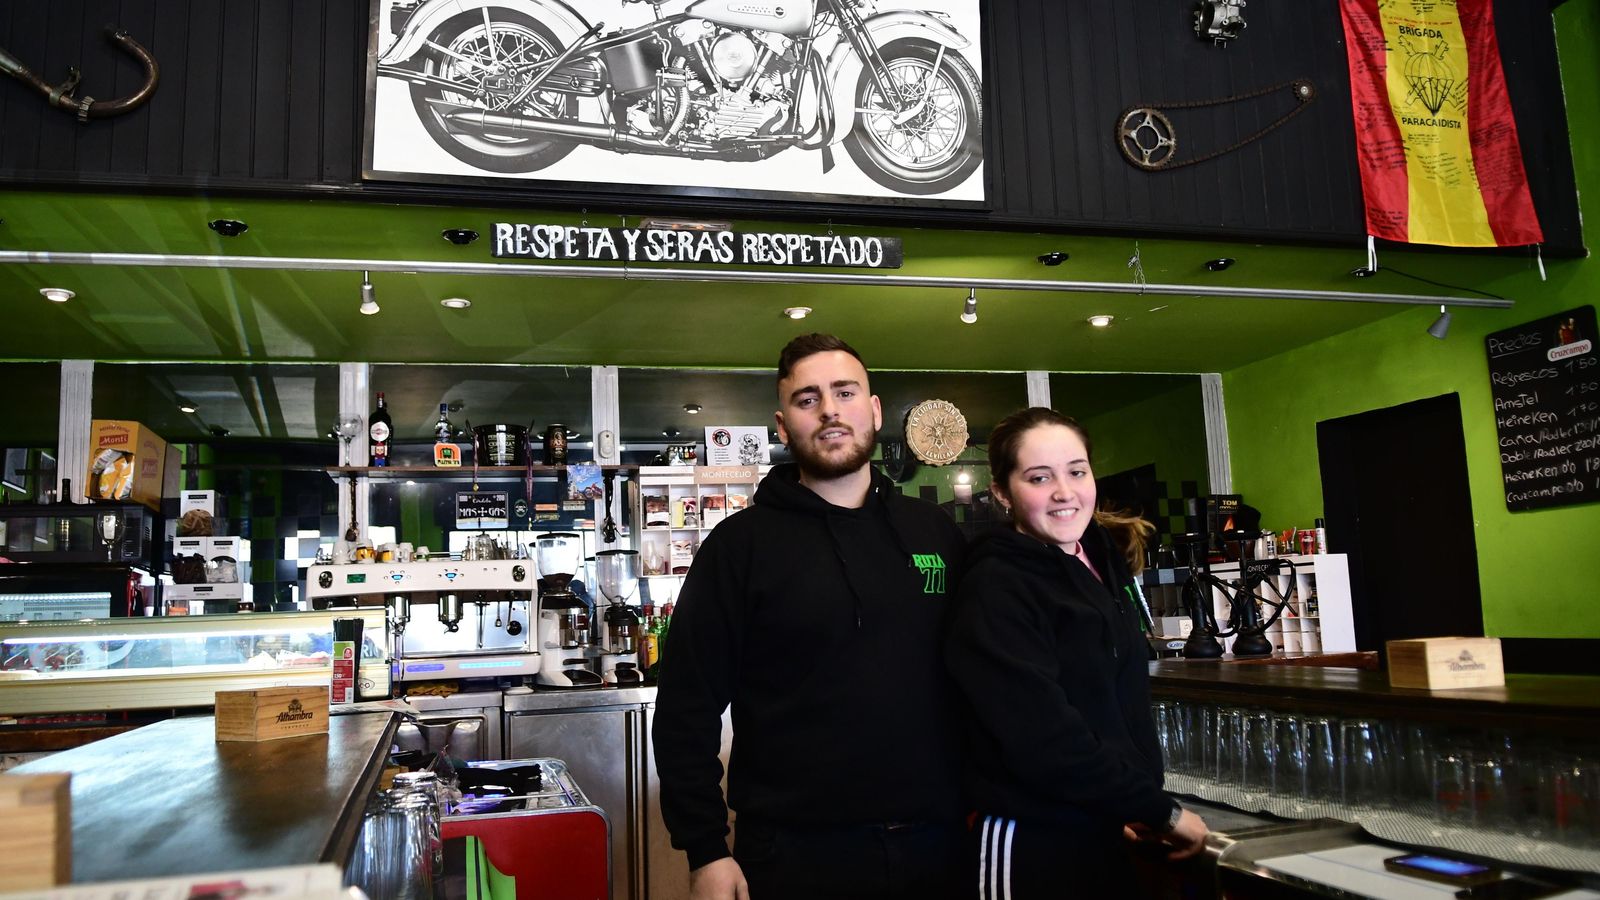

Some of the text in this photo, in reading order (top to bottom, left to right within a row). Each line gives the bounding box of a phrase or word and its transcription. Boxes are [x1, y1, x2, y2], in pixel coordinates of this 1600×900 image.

[1399, 26, 1443, 39] BRIGADA
[1402, 117, 1461, 129] PARACAIDISTA
[496, 223, 883, 267] RESPETA Y SERAS RESPETADO
[1488, 332, 1542, 353] Precios
[1550, 344, 1589, 359] Cruzcampo
[1492, 367, 1559, 387] Refrescos
[100, 435, 128, 446] Monti
[702, 470, 752, 479] MONTECELIO
[912, 553, 946, 568] RUTA
[920, 567, 945, 593] 77
[275, 710, 313, 724] Alhambra
